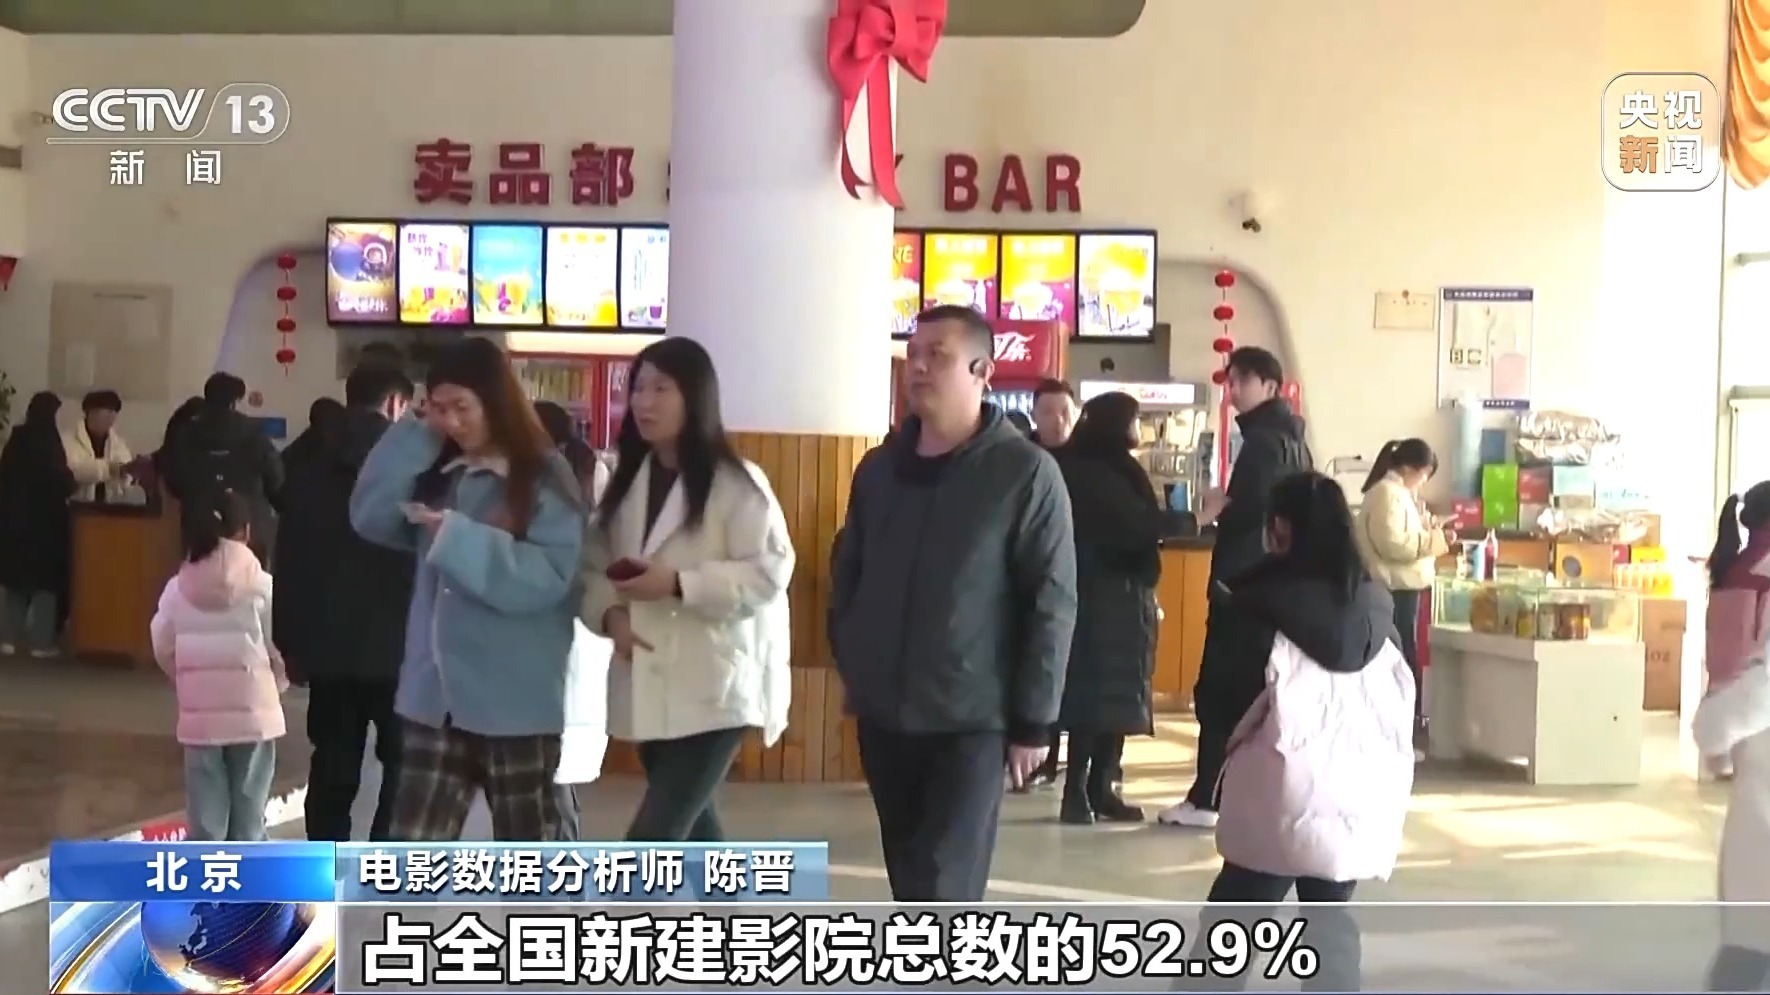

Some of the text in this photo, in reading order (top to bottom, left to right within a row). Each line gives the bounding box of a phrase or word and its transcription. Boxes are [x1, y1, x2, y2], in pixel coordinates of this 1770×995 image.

[413, 138, 635, 207] 卖品部
[943, 152, 1082, 213] BAR
